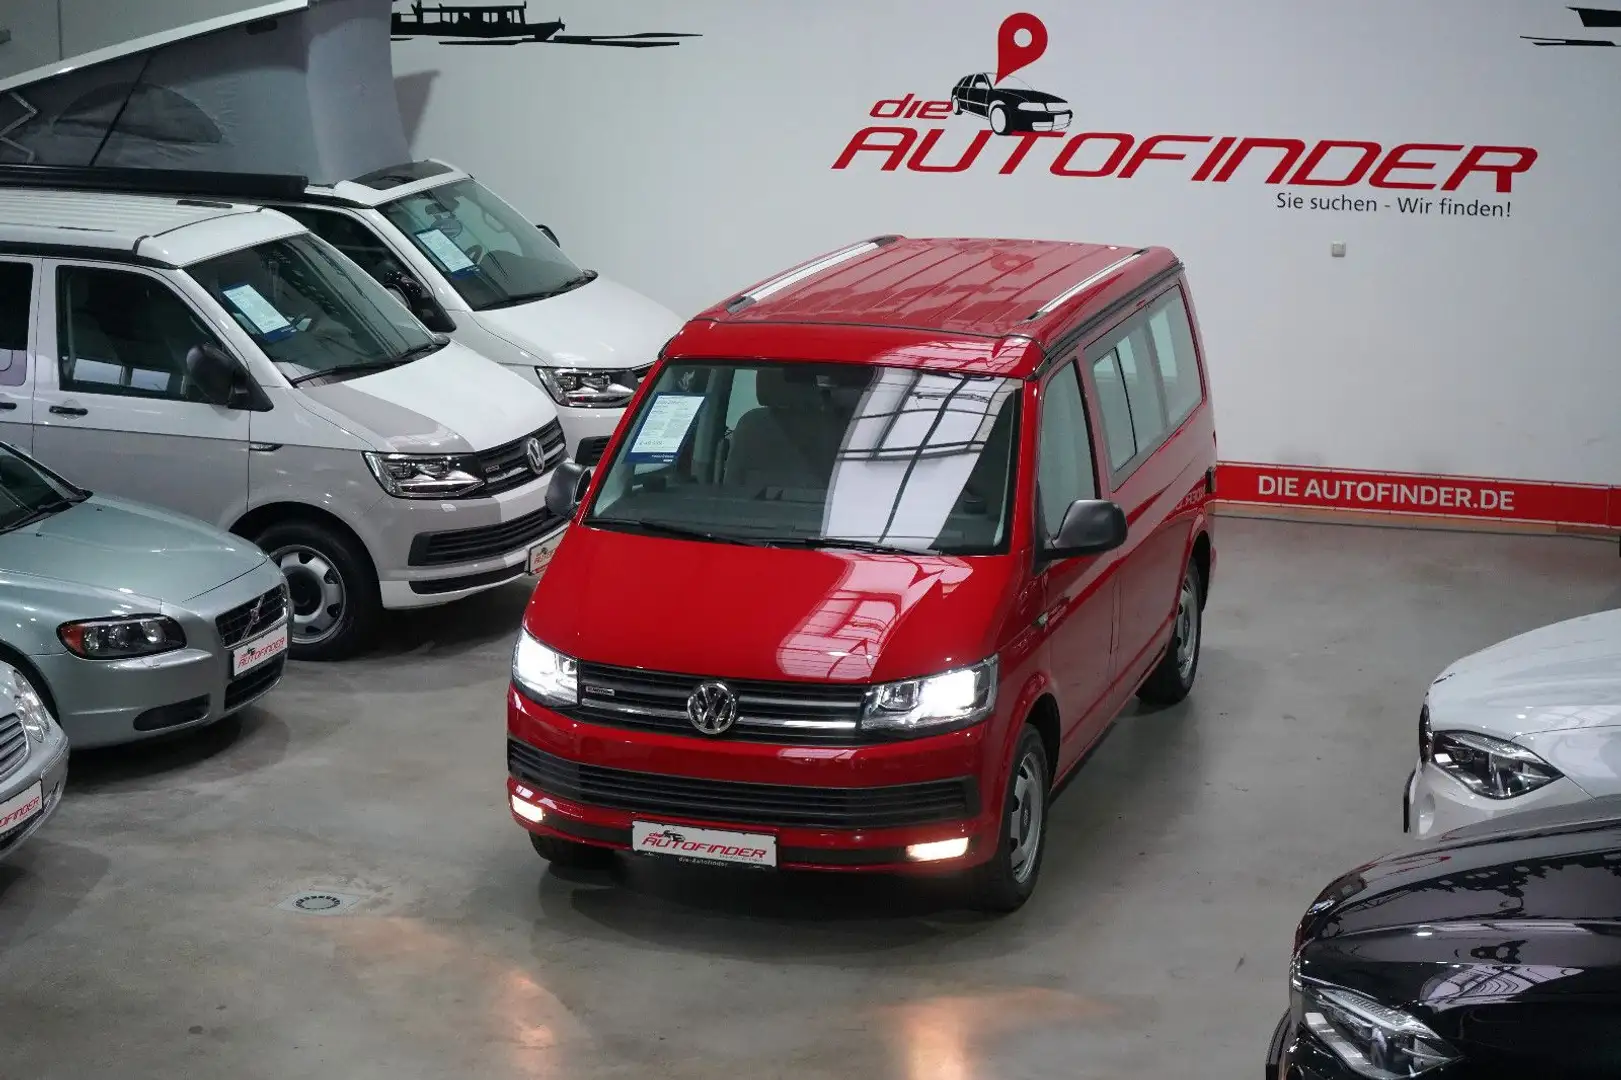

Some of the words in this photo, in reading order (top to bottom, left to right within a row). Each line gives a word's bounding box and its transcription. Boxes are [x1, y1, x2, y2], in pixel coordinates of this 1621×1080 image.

[869, 93, 954, 120] die
[830, 126, 1539, 193] AUTOFINDER
[1276, 192, 1304, 209] Sie
[1309, 194, 1378, 212] suchen
[1397, 197, 1434, 214] Wir
[1438, 198, 1512, 217] finden!
[1257, 475, 1299, 497] DIE
[1304, 478, 1516, 511] AUTOFINDER.DE
[641, 836, 767, 859] AUTOFINDER
